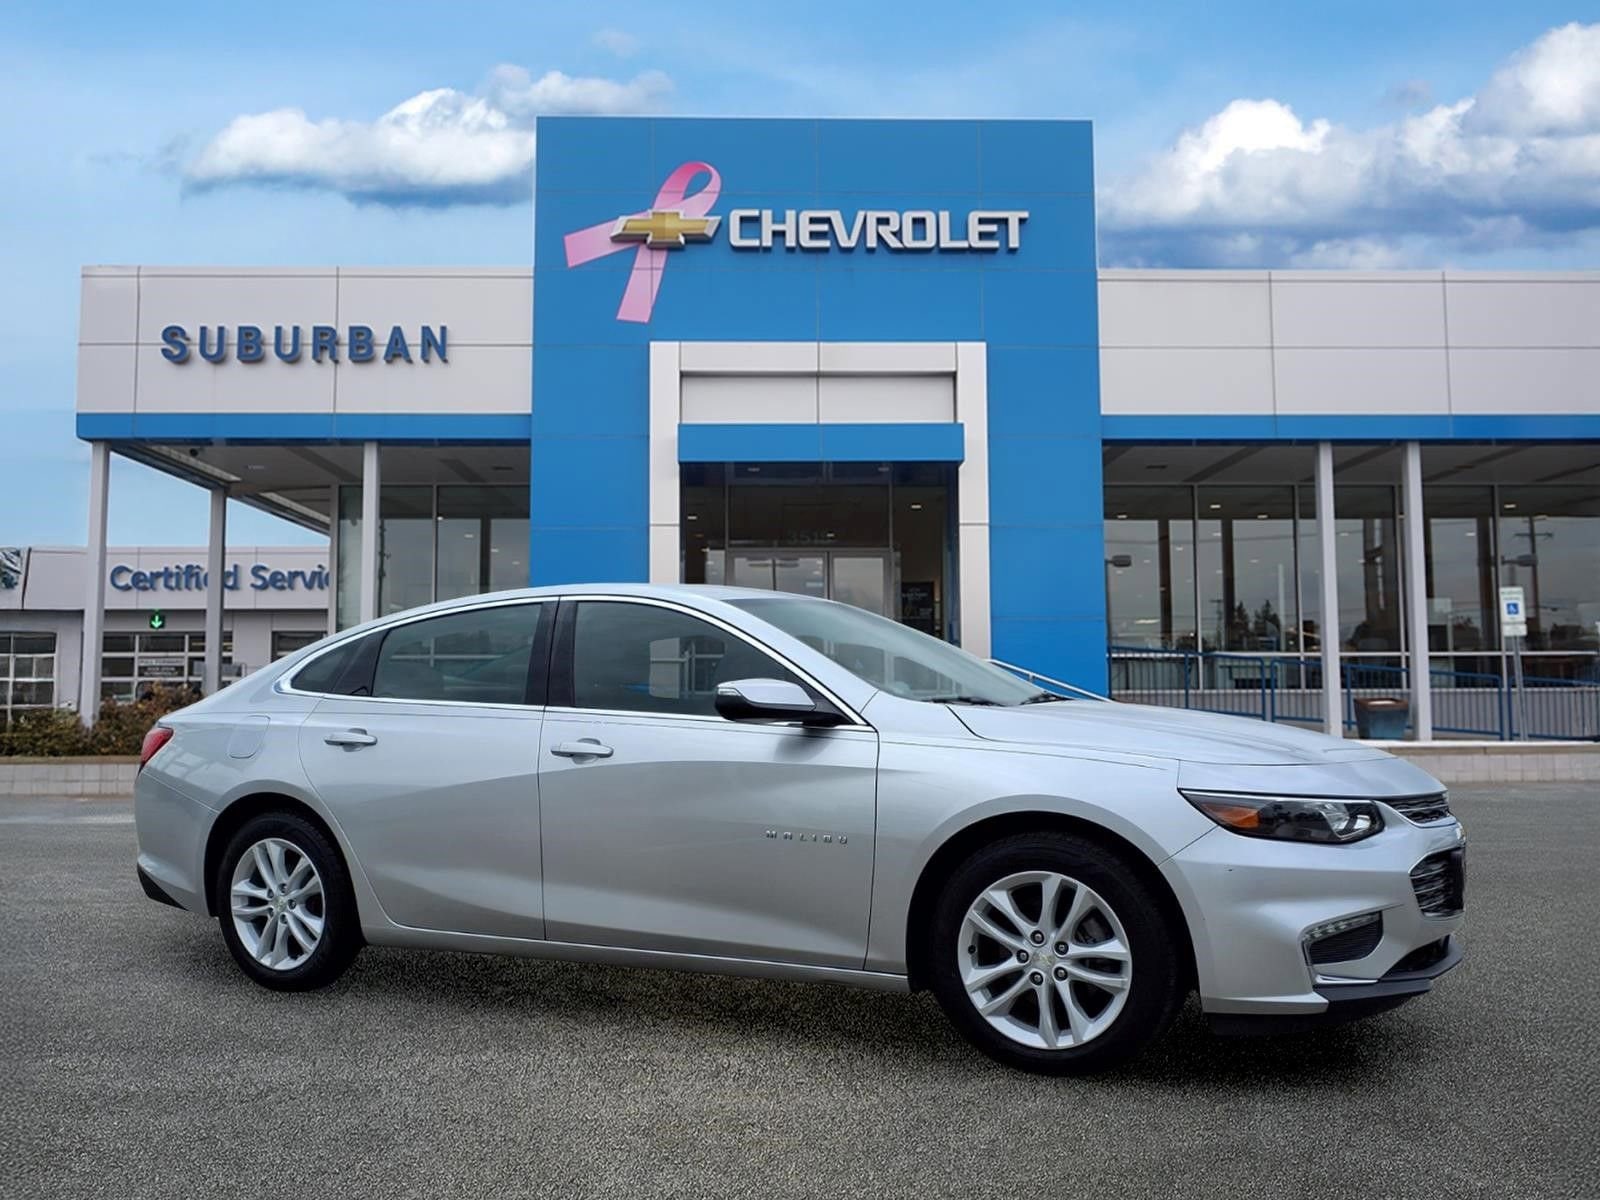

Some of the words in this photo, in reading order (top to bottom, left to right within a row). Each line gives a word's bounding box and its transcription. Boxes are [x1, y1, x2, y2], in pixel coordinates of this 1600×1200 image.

[729, 208, 1029, 250] CHEVROLET
[161, 325, 449, 364] SUBURBAN
[110, 564, 240, 591] Certifid
[250, 563, 329, 591] Servi
